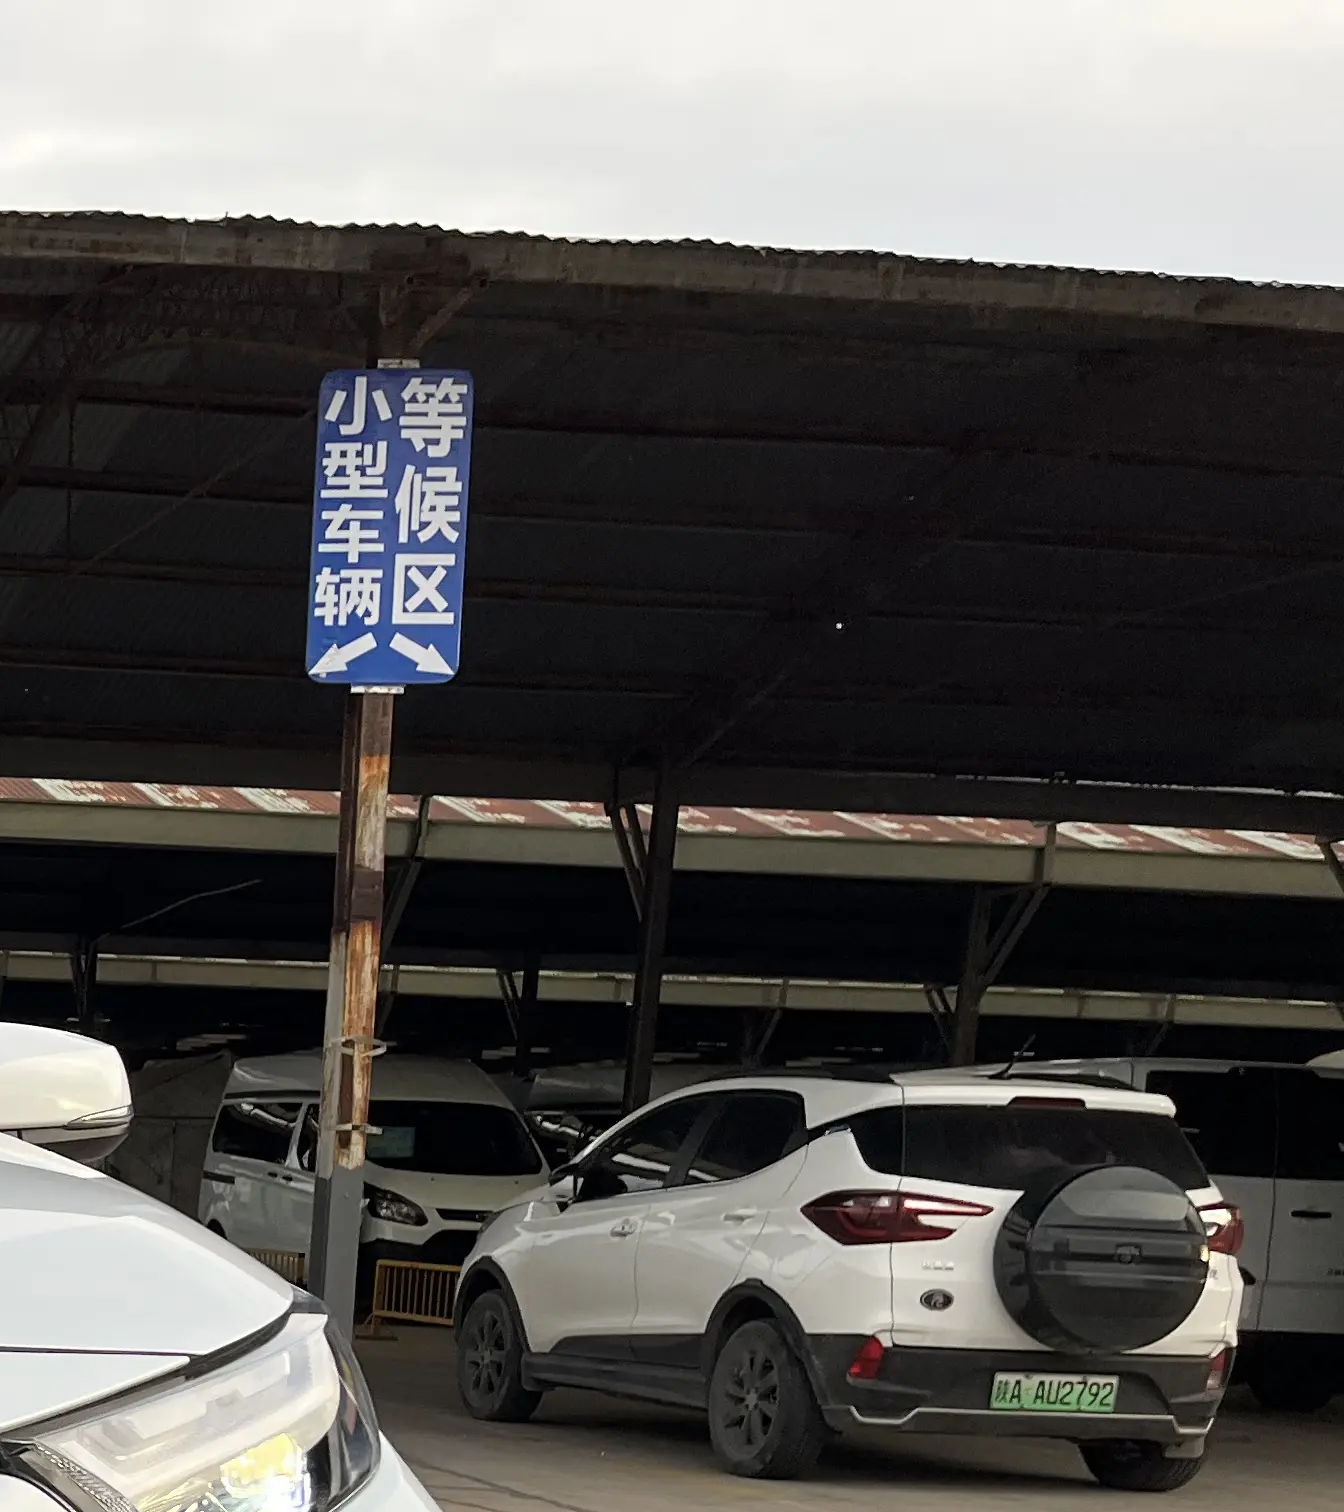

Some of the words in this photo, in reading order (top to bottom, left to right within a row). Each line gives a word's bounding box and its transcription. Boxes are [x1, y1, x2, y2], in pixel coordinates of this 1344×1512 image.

[313, 375, 394, 627] 小型车辆
[391, 376, 469, 625] 等候区
